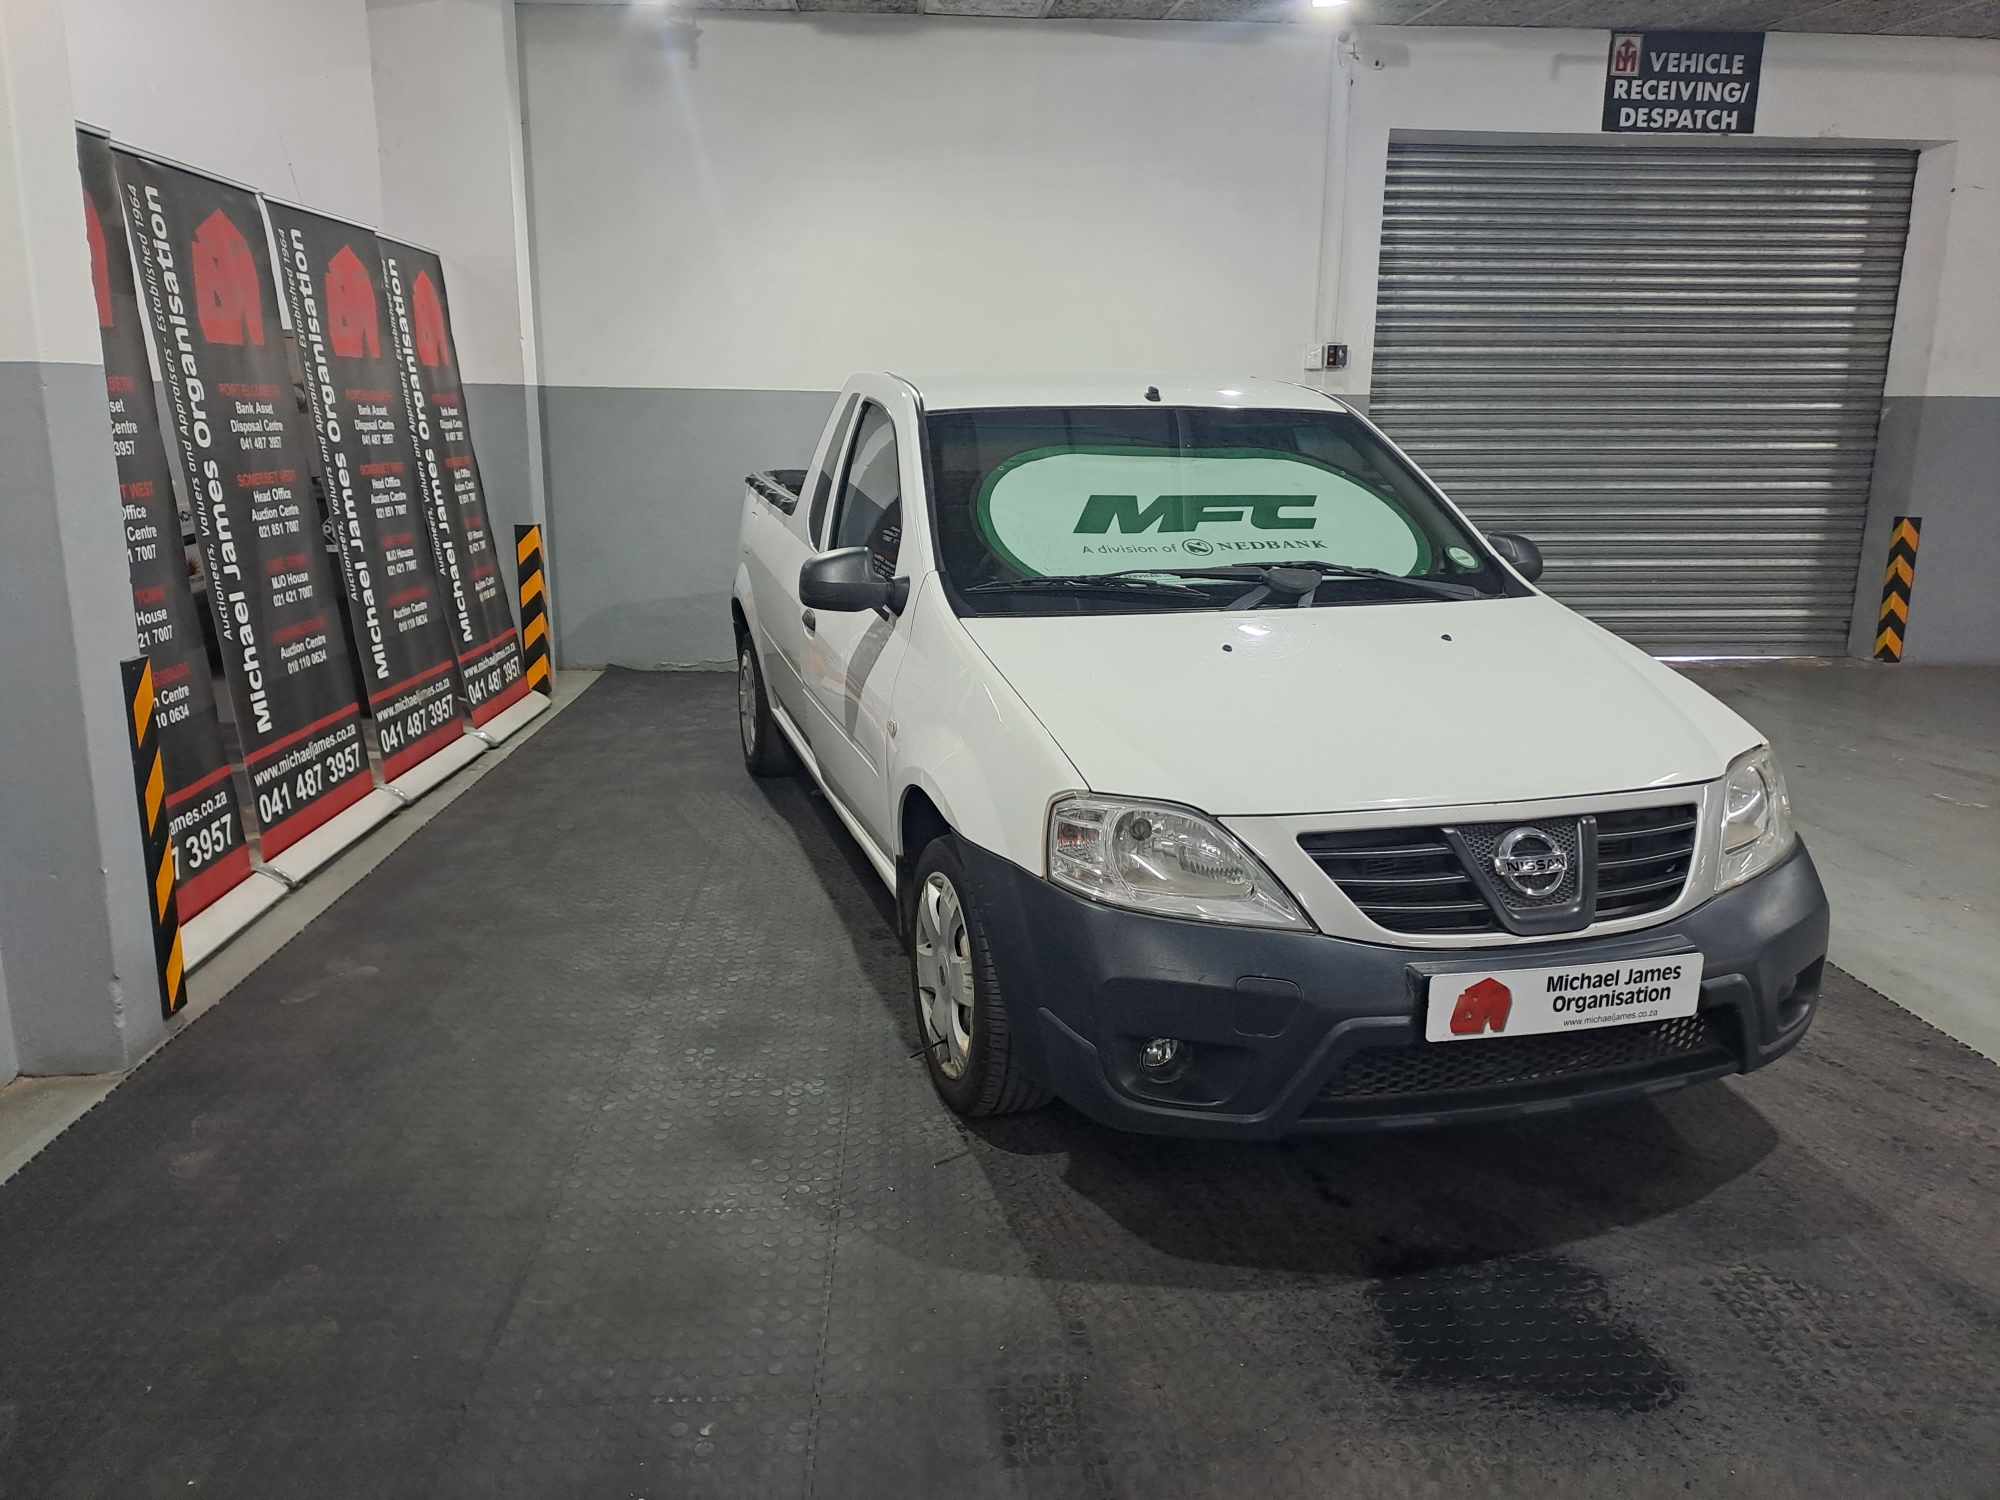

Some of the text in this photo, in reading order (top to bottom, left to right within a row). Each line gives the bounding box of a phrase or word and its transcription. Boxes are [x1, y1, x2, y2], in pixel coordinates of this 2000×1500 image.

[1650, 52, 1745, 75] VEHICLE
[1613, 79, 1750, 103] RECEIVING/
[1619, 107, 1738, 130] DESPATCH
[127, 184, 145, 227] 1964
[137, 231, 167, 332] Established
[285, 266, 308, 348] Established
[388, 258, 430, 441] Organisation
[164, 348, 189, 436] Appraisers
[235, 401, 255, 414] Bank
[305, 361, 324, 433] Appraisers
[114, 440, 135, 456] 3957
[144, 185, 272, 733] Michael James Organisation
[182, 440, 197, 472] and
[290, 228, 390, 679] Michael James Organisation
[318, 435, 330, 462] and
[253, 487, 292, 503] Head Office
[326, 466, 341, 515] Valuers
[426, 447, 450, 534] James
[192, 477, 210, 536] Valuers
[251, 508, 278, 522] Auction
[1072, 494, 1318, 535] MFC
[127, 525, 158, 542] Centre
[1082, 539, 1329, 555] A division of NEDBANK
[135, 544, 156, 561] 7007
[338, 520, 358, 601] Auctioneers,
[207, 543, 232, 640] Auctioneers,
[287, 572, 309, 585] House
[442, 541, 473, 642] Michael
[136, 608, 168, 626] House
[152, 625, 173, 644] 7007
[280, 642, 305, 659] Auction
[161, 684, 190, 705] Centre
[468, 677, 488, 704] 041
[502, 655, 521, 683] 3957
[169, 703, 190, 724] 0634
[380, 693, 453, 753] 041 487 3957
[254, 723, 356, 787] www.michaeljames.co.za
[259, 742, 360, 823] 041 487 3957
[186, 813, 232, 868] 3957
[1506, 857, 1565, 872] NISSAN
[1546, 964, 1682, 993] Michael James
[1552, 984, 1671, 1014] Organisation
[1563, 1009, 1658, 1027] www.michaeljames.co.za
